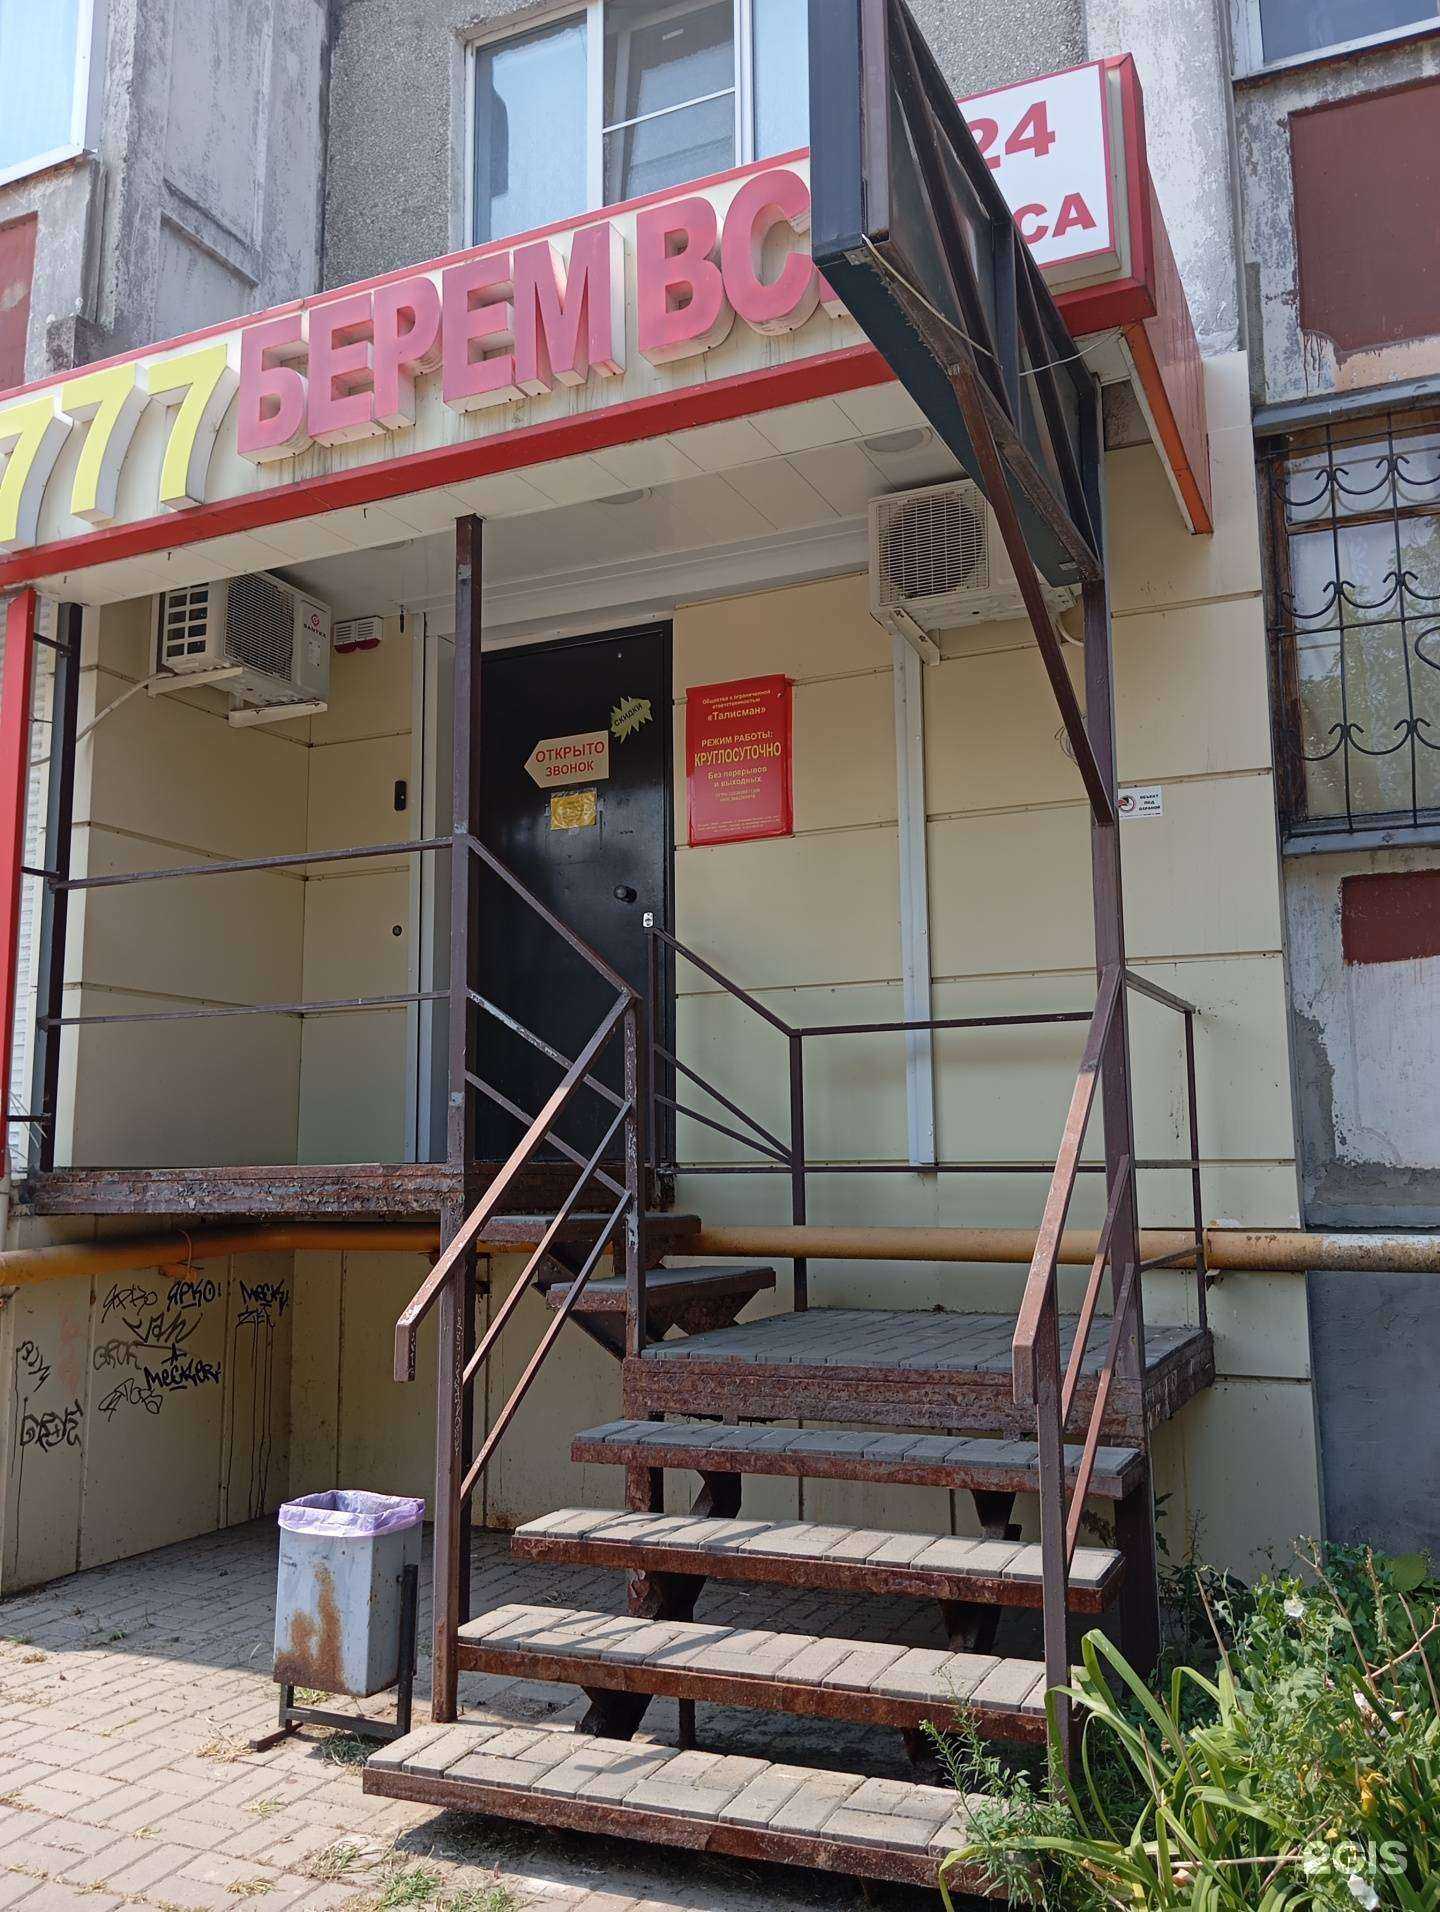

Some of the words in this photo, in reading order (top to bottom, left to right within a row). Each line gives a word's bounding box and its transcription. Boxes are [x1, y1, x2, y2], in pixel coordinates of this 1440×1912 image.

[237, 222, 615, 458] БЕРЕМ
[636, 169, 842, 357] ВС
[614, 702, 644, 727] СКИДКИ
[708, 706, 766, 721] «Талисман»
[701, 735, 733, 748] РЕЖИМ
[735, 731, 773, 743] РАБОТЫ:
[535, 741, 605, 763] ОТКРЫТО
[695, 742, 782, 767] КРУГЛОСУТОЧНО
[546, 760, 594, 777] ЗВОНОК
[708, 770, 722, 780] Без
[721, 777, 762, 788] выходных
